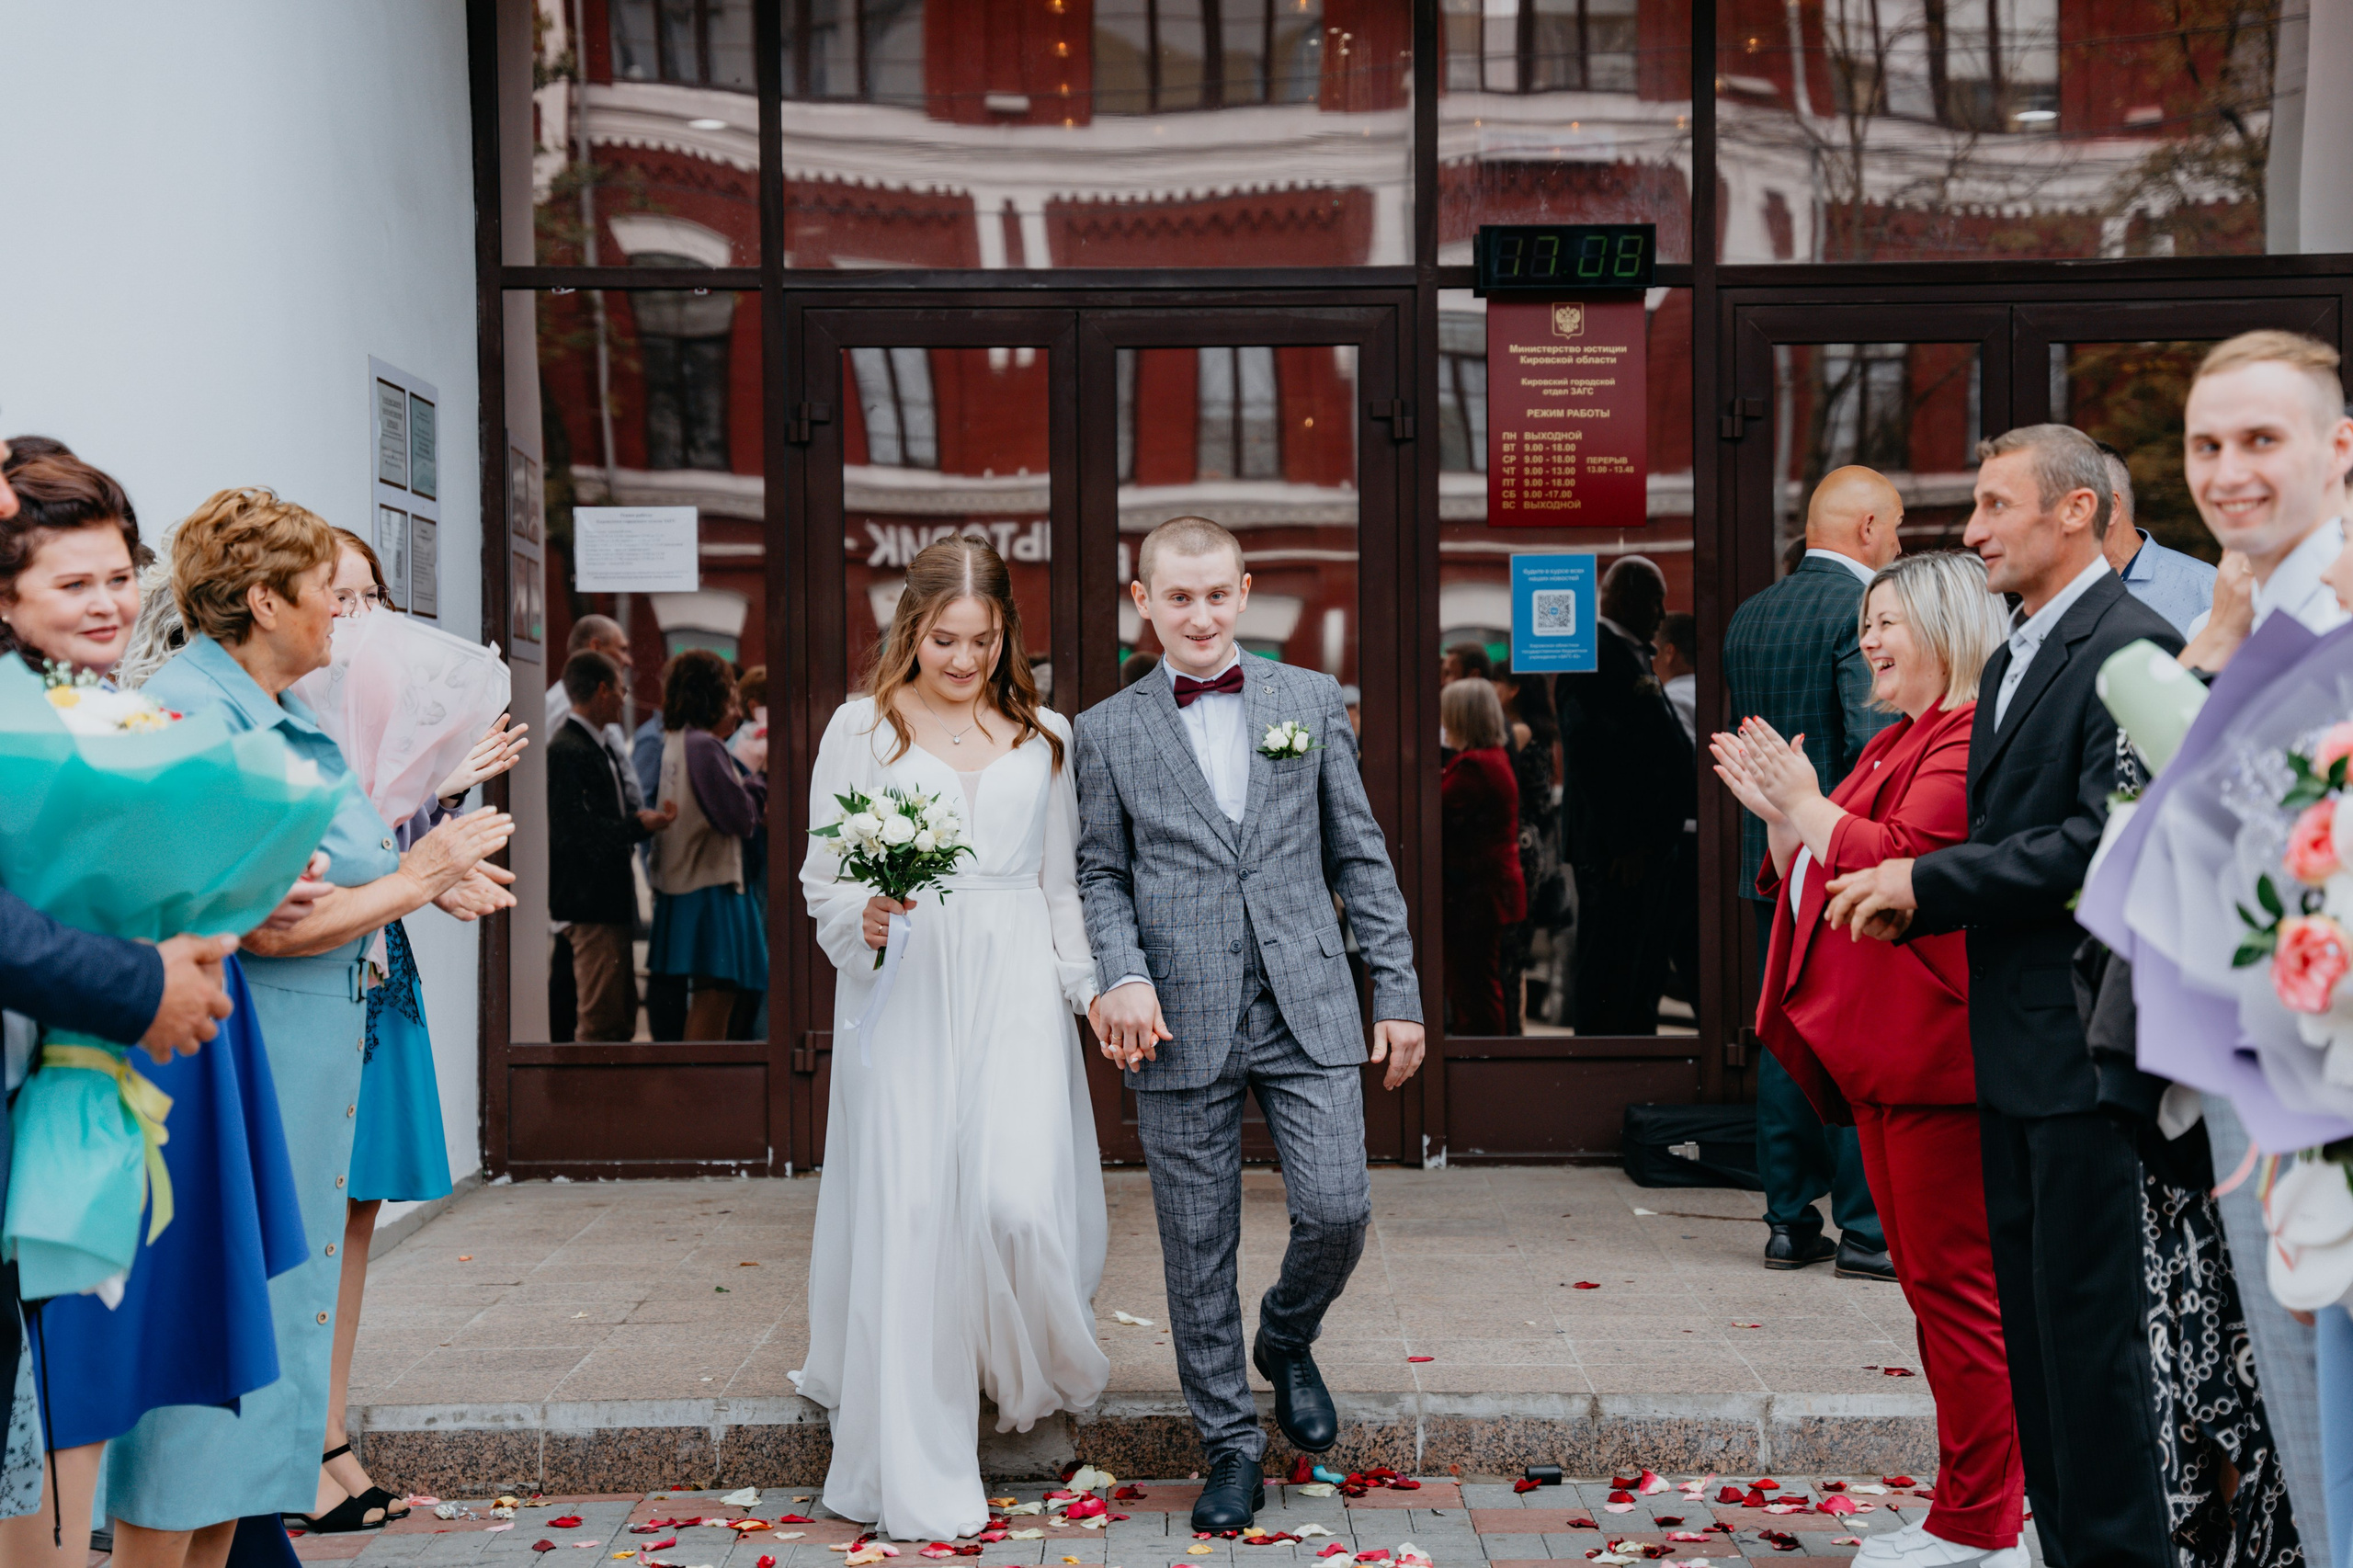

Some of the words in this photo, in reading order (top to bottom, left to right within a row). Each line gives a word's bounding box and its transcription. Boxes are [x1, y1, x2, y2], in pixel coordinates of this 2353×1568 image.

[1508, 344, 1581, 355] Министерство
[1583, 345, 1627, 354] юстиции
[1519, 355, 1574, 366] Кировской
[1575, 355, 1617, 364] области
[1520, 377, 1568, 387] Кировский
[1570, 378, 1615, 387] городской
[1542, 388, 1568, 396] отдел
[1527, 409, 1564, 418] РЕЖИМ
[1566, 409, 1610, 418] РАБОТЫ
[1502, 432, 1517, 440] ПН
[1523, 430, 1583, 441] ВЫХОДНОЙ
[1502, 443, 1517, 452] ВТ
[1523, 443, 1543, 452] 9.00
[1552, 443, 1576, 452] 18.00
[1502, 455, 1517, 464] СР
[1523, 455, 1543, 464] 9.00
[1552, 455, 1576, 464] 18.00
[1502, 467, 1517, 476] ЧТ
[1523, 467, 1543, 476] 9.00
[1552, 467, 1576, 476] 13.00
[1502, 478, 1517, 487] ПТ
[1523, 478, 1543, 487] 9.00
[1552, 478, 1576, 487] 18.00
[1502, 490, 1517, 499] СБ
[1523, 490, 1542, 499] 9.00
[1502, 501, 1517, 509] ВС
[1523, 499, 1582, 510] ВЫХОДНОЙ
